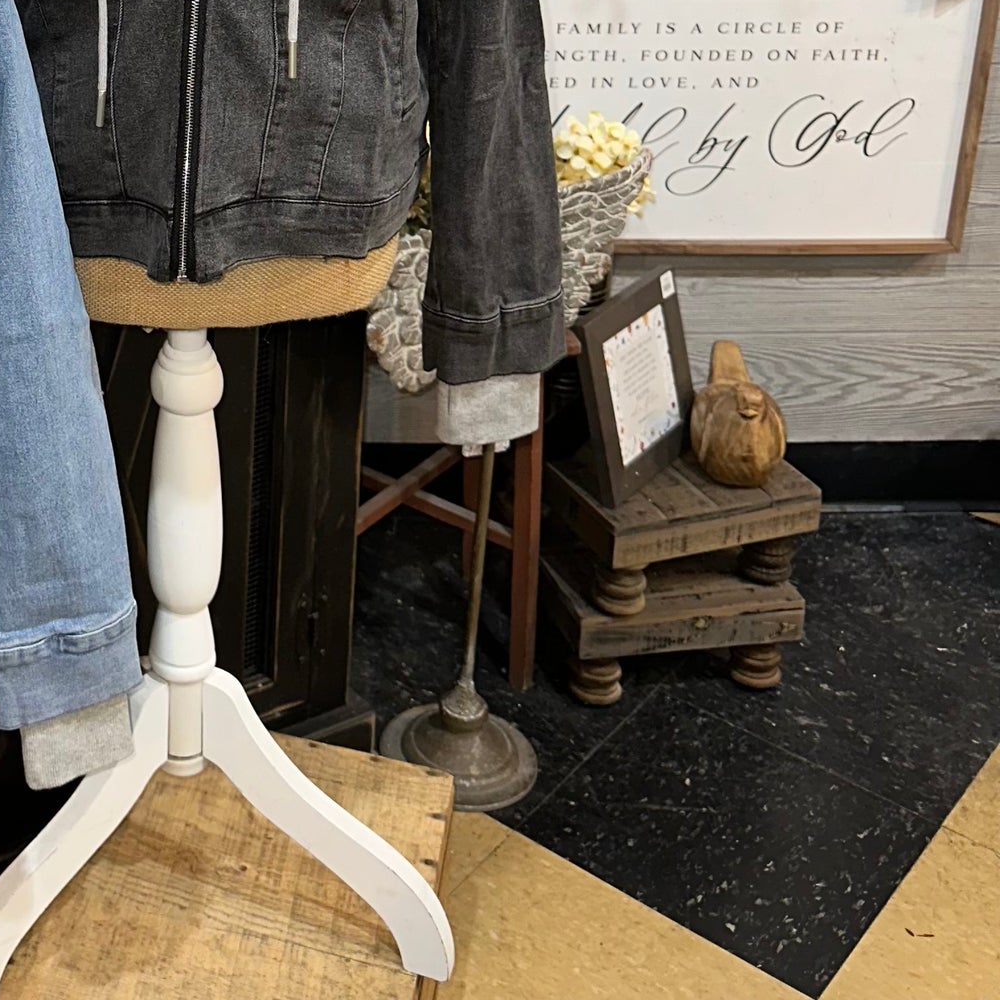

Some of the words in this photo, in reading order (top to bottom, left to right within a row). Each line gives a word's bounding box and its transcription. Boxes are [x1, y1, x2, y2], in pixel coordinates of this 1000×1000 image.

[556, 22, 642, 35] FAMILY
[656, 22, 677, 35] IS
[690, 22, 703, 35] A
[717, 21, 802, 34] CIRCLE
[816, 21, 845, 34] OF
[544, 49, 626, 63] ENGTH,
[640, 49, 753, 62] FOUNDED
[767, 49, 798, 62] ON
[812, 48, 888, 62] FAITH,
[591, 76, 614, 89] IN
[628, 76, 696, 90] LOVE,
[711, 76, 759, 89] AND
[665, 102, 748, 196] by
[768, 94, 915, 168] God
